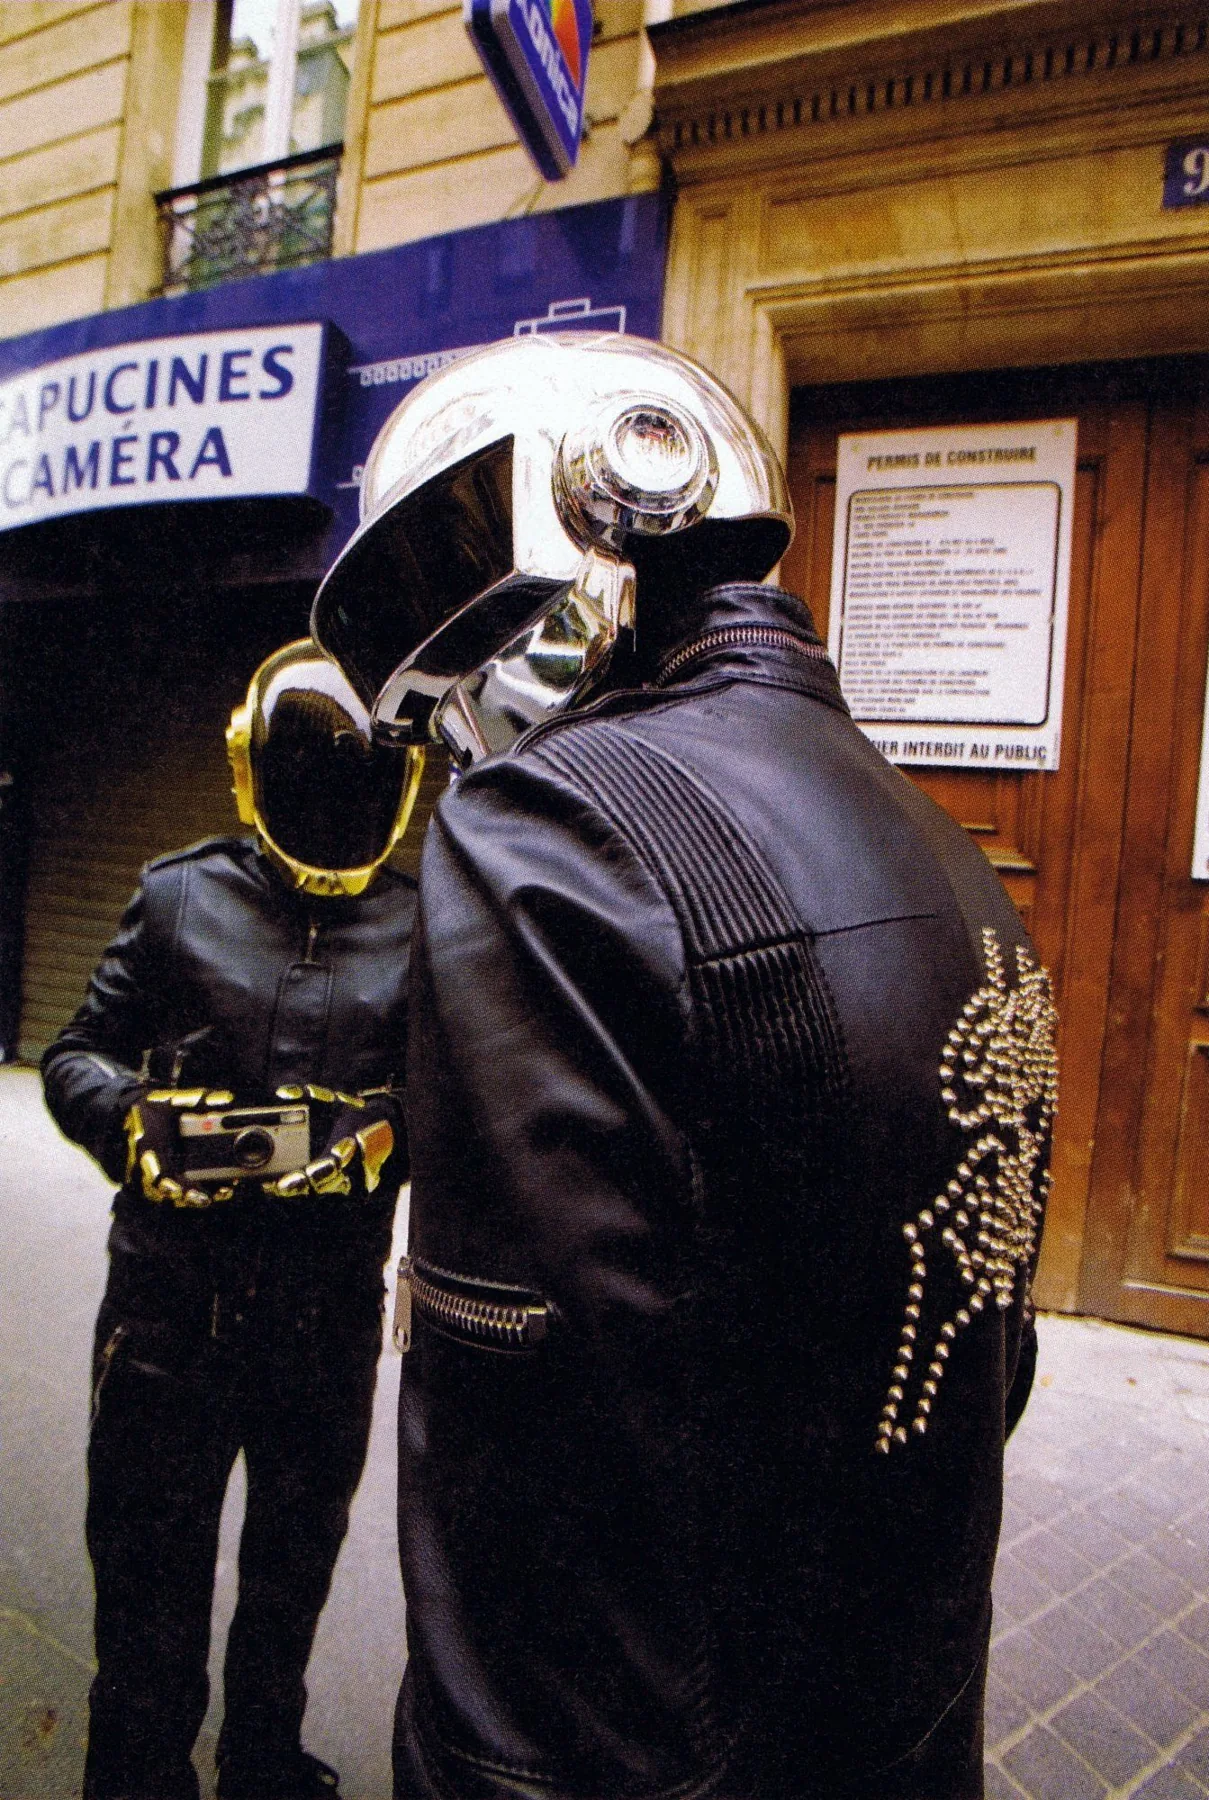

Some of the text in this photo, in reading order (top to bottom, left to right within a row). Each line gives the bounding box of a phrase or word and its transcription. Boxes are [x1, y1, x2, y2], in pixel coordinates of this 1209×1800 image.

[0, 344, 294, 445] APUCINES
[3, 420, 233, 508] CAMÉRA
[903, 741, 965, 757] INTERDIT
[970, 744, 989, 759] AU
[995, 744, 1047, 760] PUBLIC
